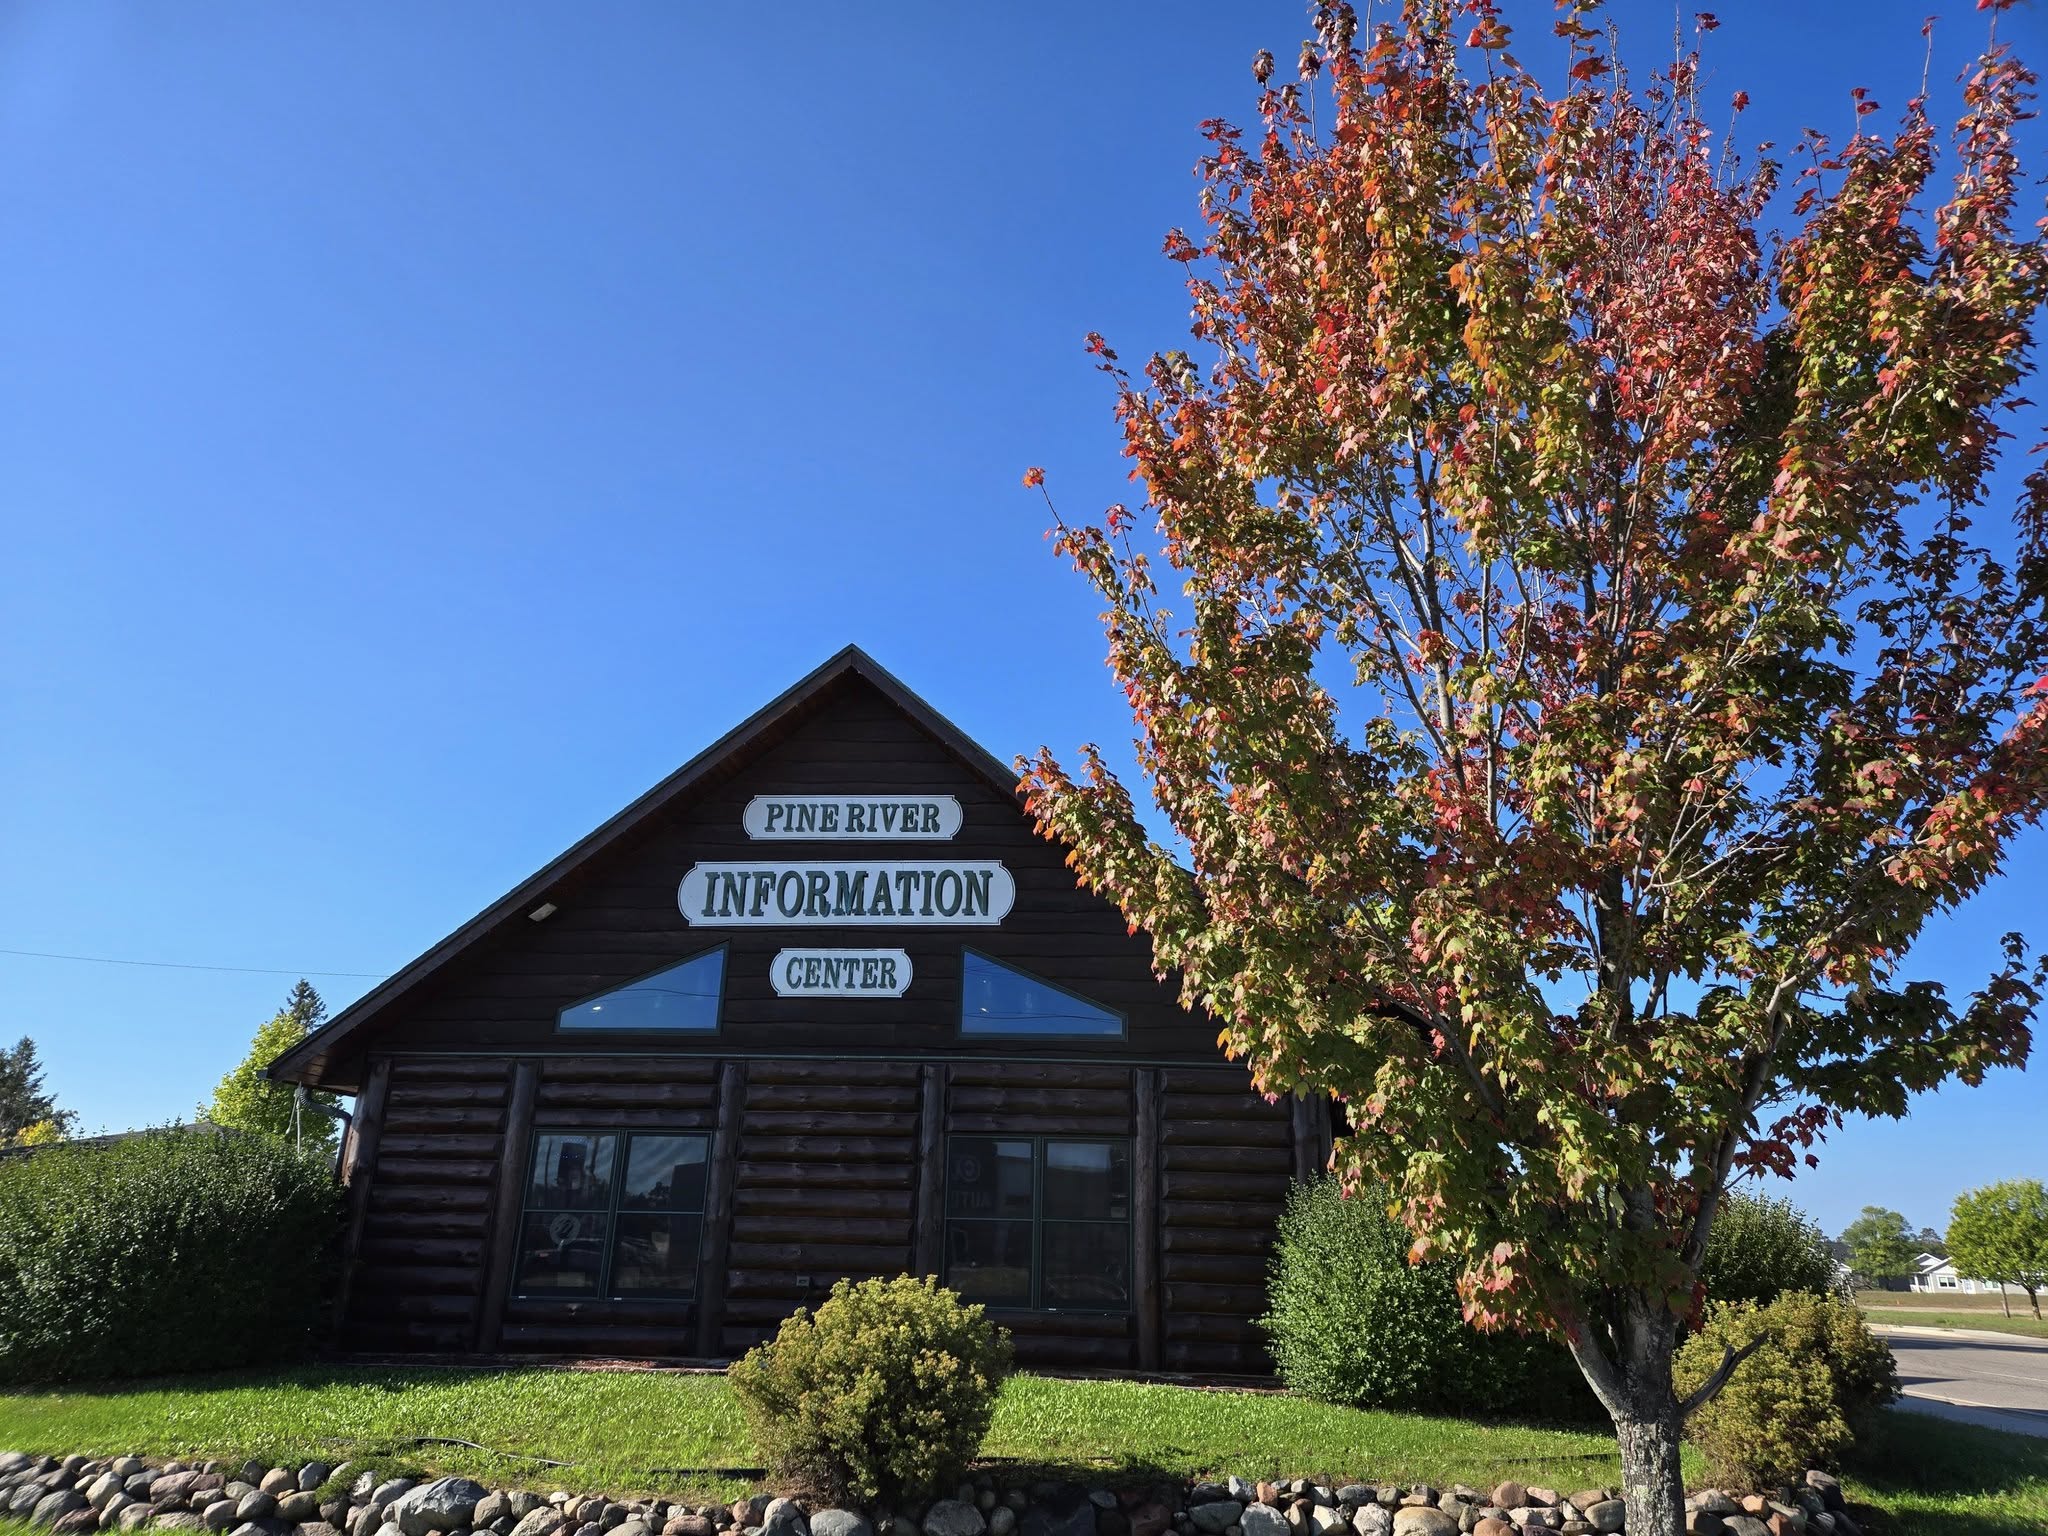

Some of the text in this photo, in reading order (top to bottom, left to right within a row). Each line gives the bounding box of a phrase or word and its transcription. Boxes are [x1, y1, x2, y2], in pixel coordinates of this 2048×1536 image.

[764, 803, 941, 832] PINE RIVER
[701, 869, 994, 918] INFORMATION
[786, 957, 897, 989] CENTER
